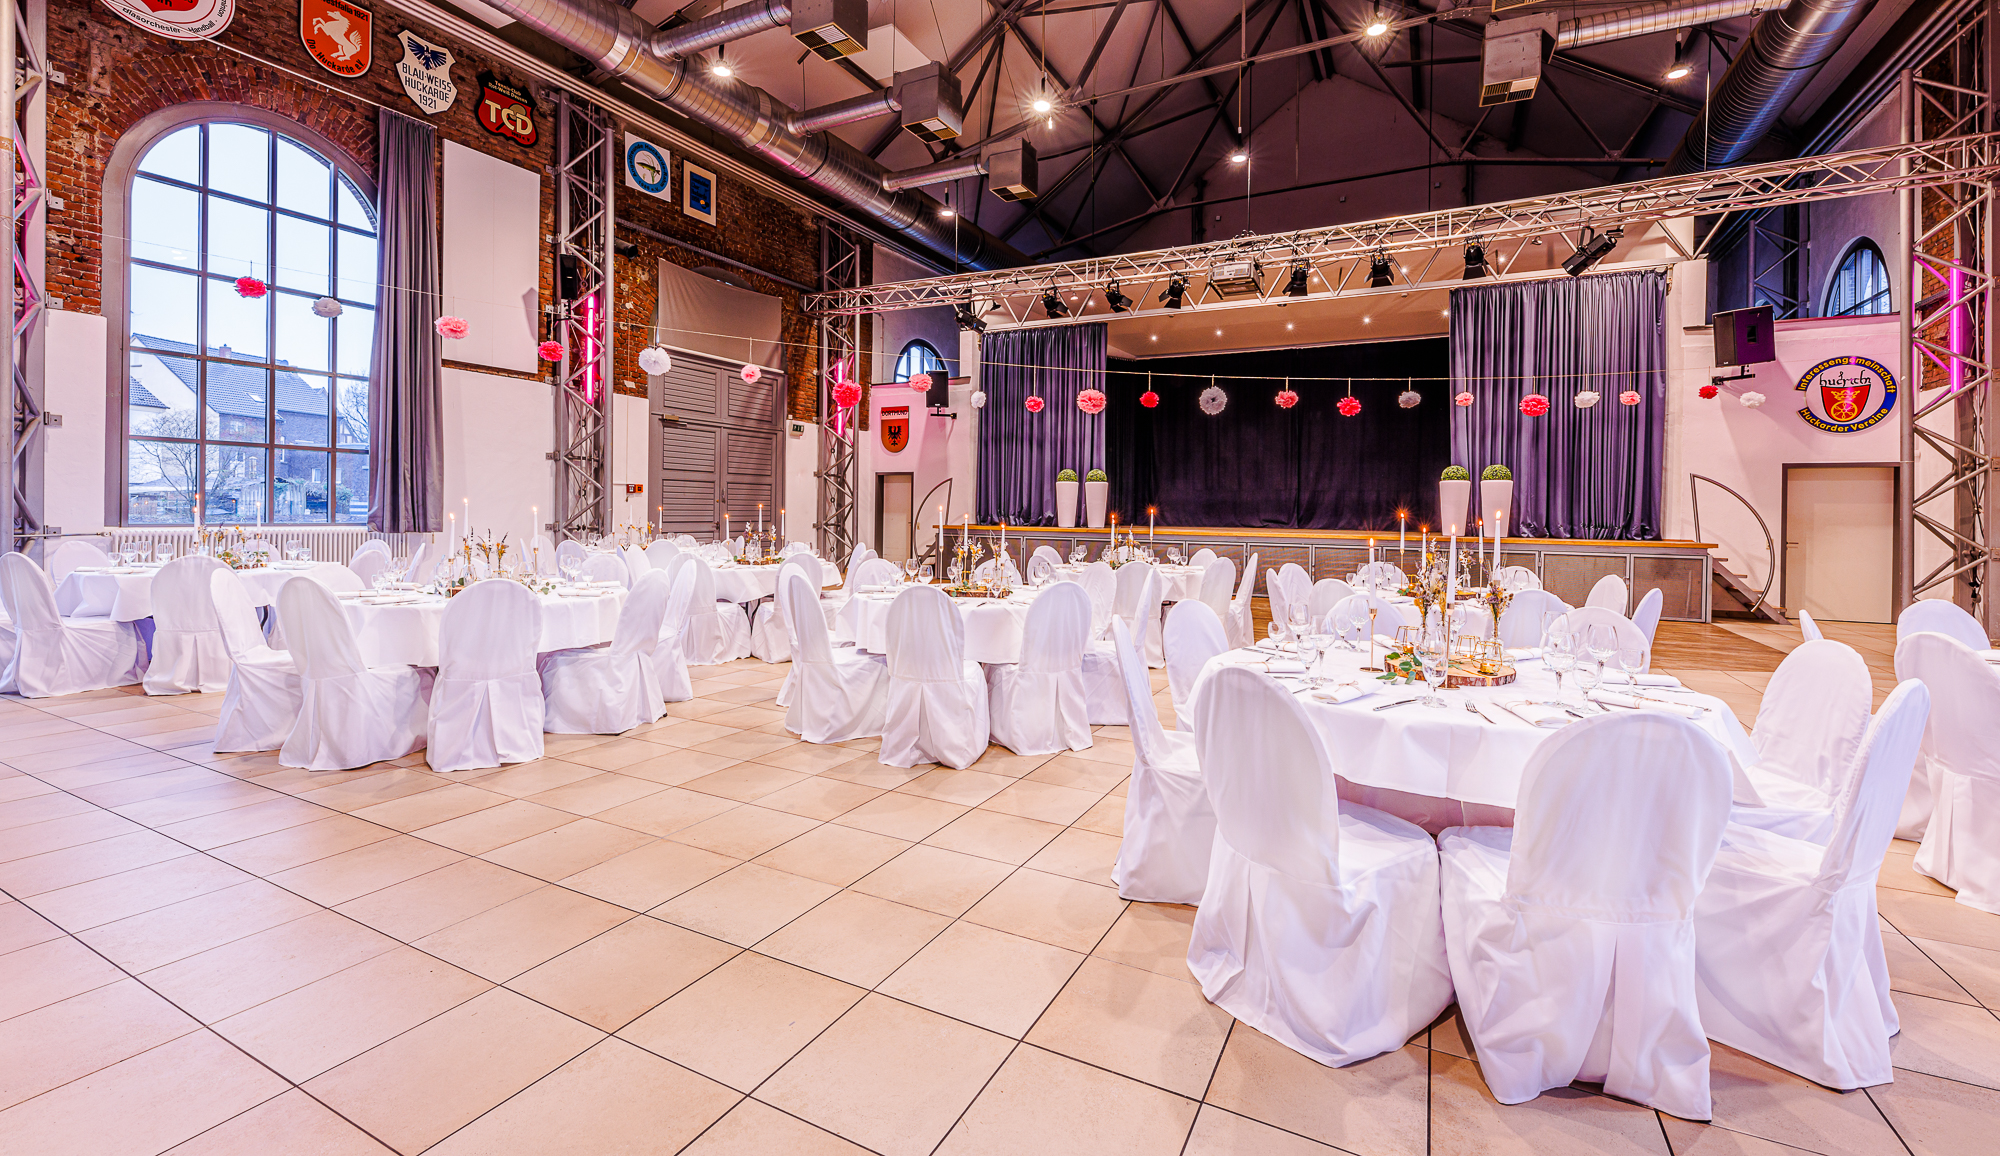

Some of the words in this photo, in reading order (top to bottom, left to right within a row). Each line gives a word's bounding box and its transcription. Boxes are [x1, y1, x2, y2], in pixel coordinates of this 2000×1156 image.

[323, 0, 353, 14] estfalia
[353, 9, 369, 22] 1921
[404, 76, 450, 103] HUCKARDE
[418, 93, 437, 110] 1921
[484, 98, 533, 135] TCD
[1797, 357, 1897, 394] Interessengemeinschaft
[1800, 408, 1850, 432] Huckarder
[1849, 407, 1889, 431] Vereine
